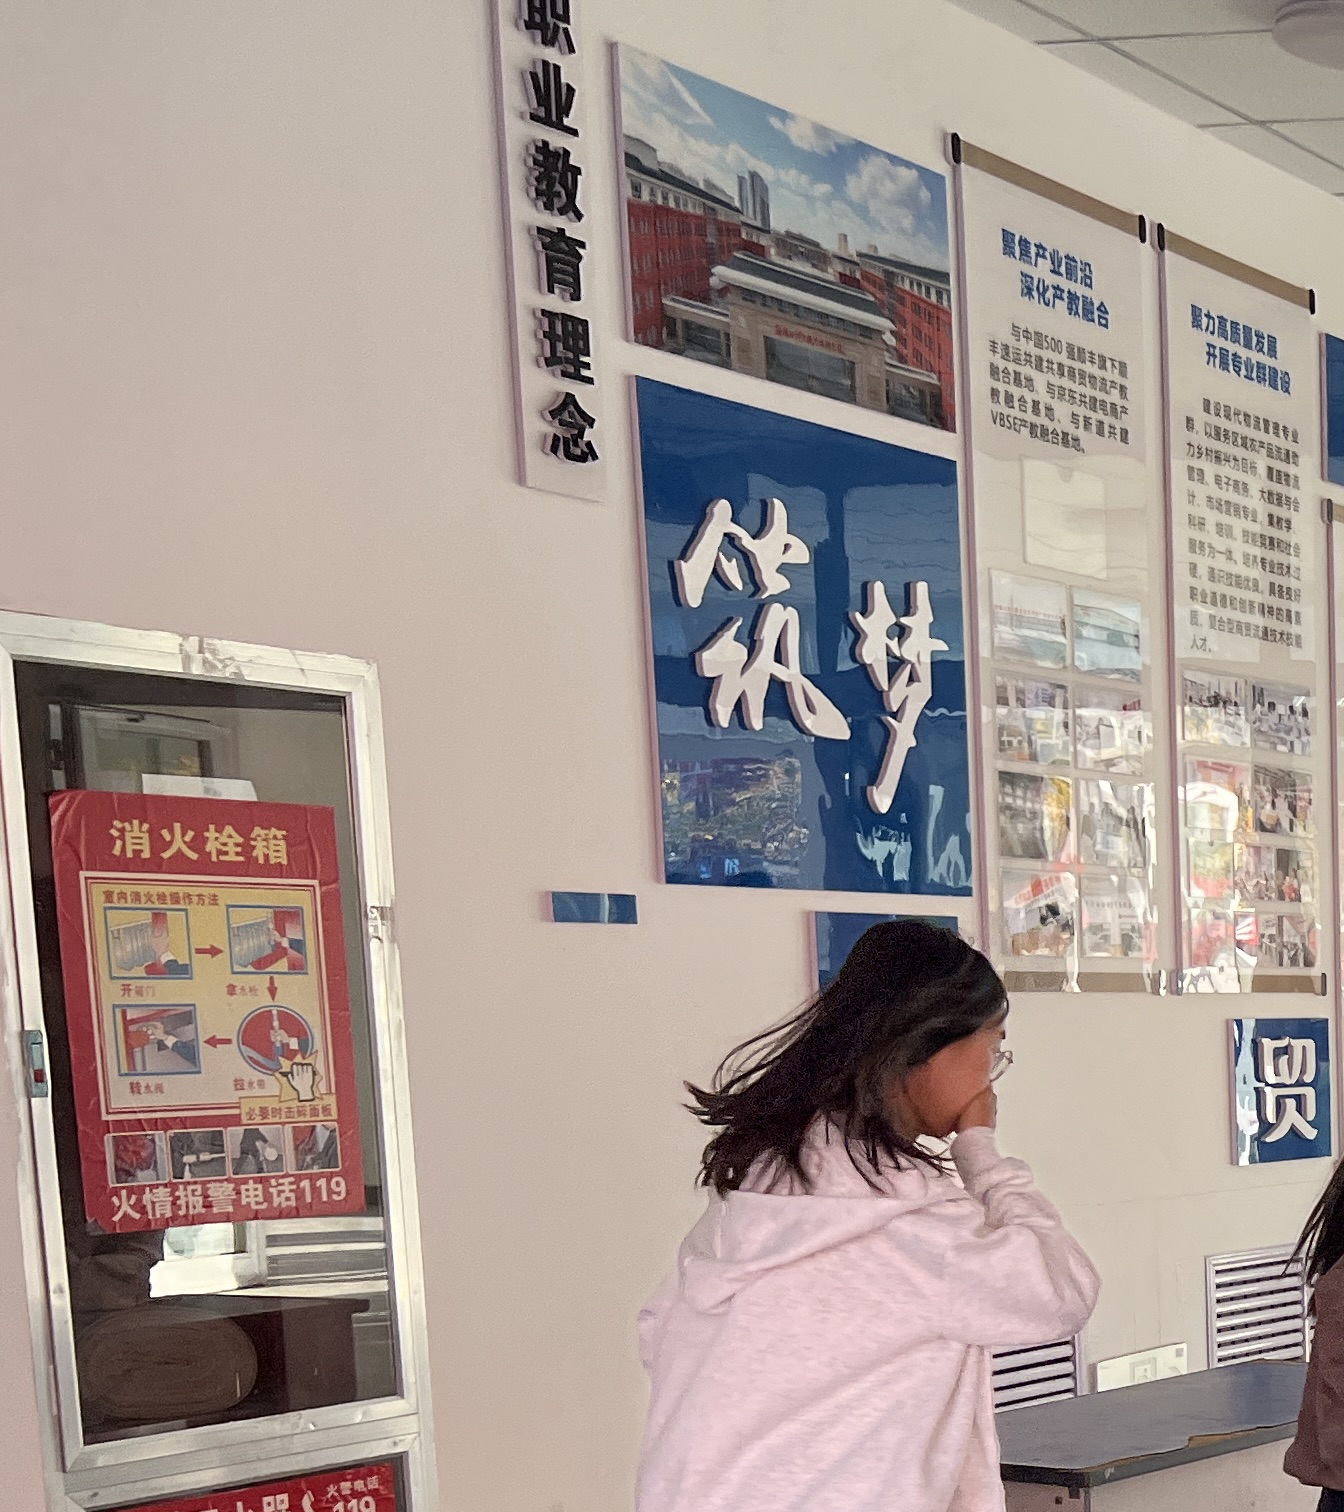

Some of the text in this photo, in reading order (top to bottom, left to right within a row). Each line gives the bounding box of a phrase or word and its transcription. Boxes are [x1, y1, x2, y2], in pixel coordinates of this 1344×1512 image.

[521, 0, 599, 465] 职业教育理念
[1001, 228, 1094, 290] 聚焦产业前沿
[1020, 270, 1110, 329] 深化产教融合
[1205, 342, 1291, 396] 开展专业群建设
[108, 819, 289, 866] 消火栓箱
[102, 890, 219, 906] 室内消火栓操作方法
[1260, 1036, 1319, 1143] 贸
[110, 1175, 347, 1223] 火情报警电话119
